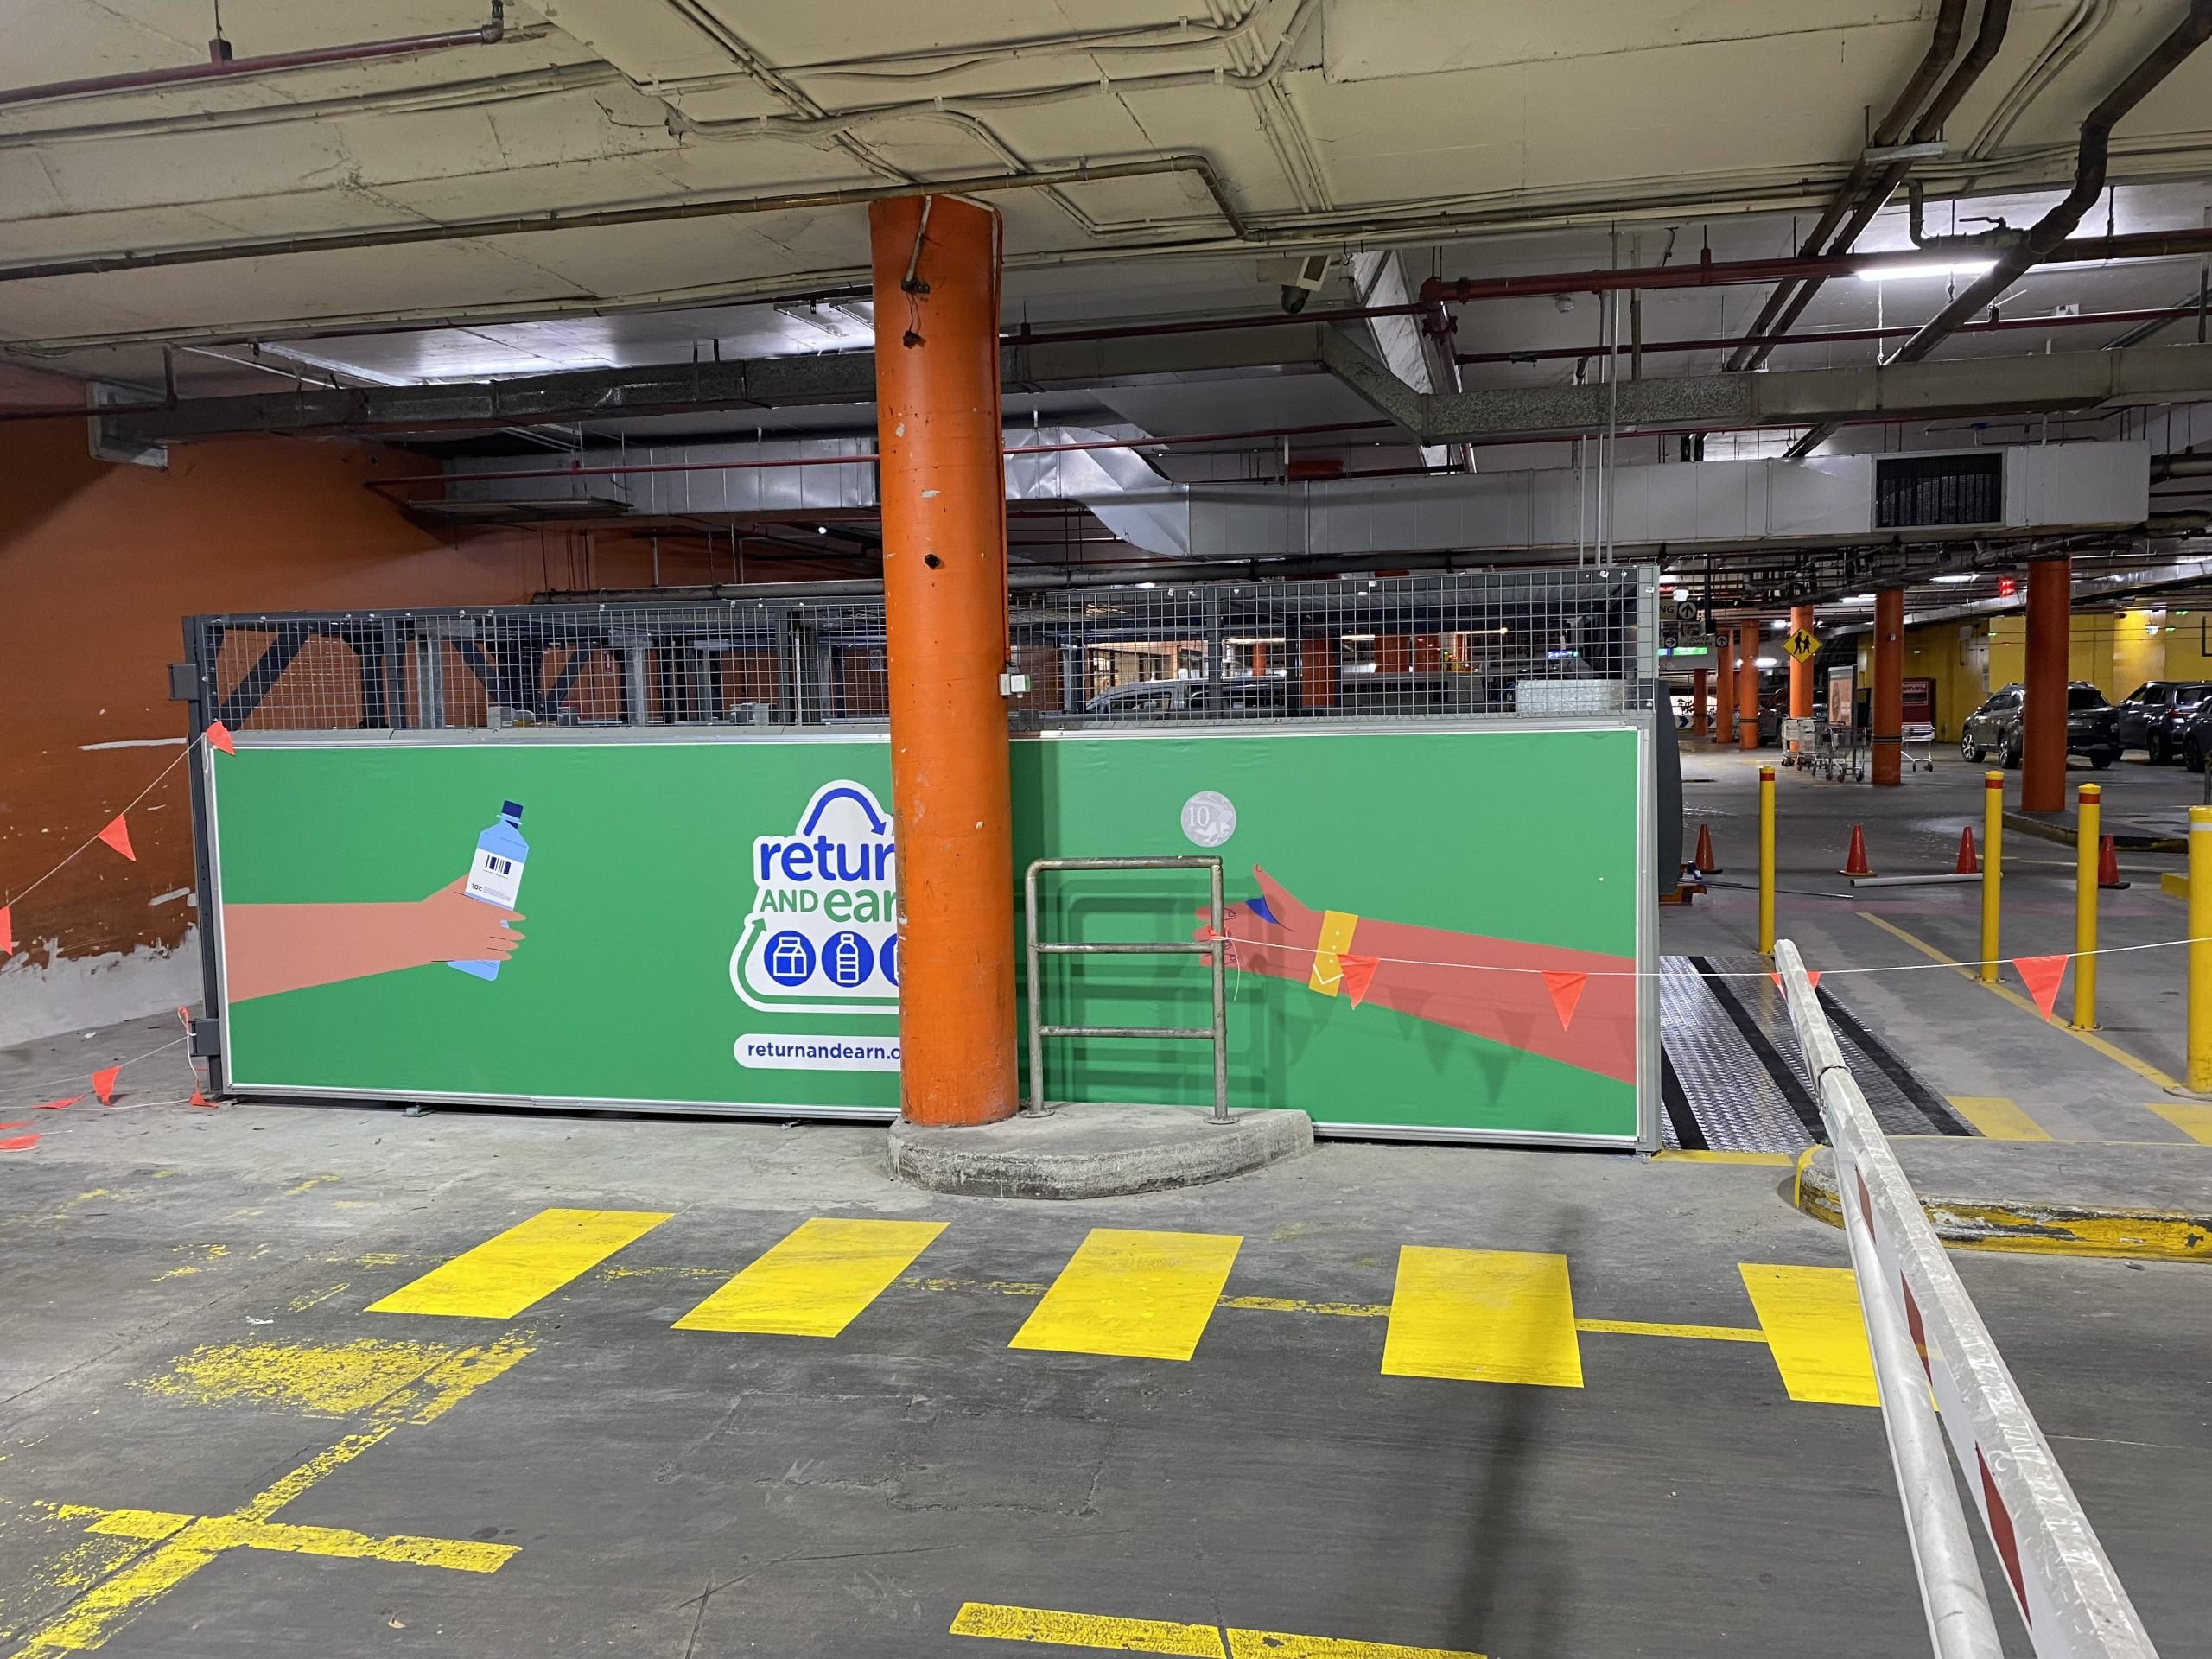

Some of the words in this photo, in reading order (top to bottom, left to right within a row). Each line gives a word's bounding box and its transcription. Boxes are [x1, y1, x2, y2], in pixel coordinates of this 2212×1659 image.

[1189, 805, 1210, 826] 10
[760, 835, 895, 881] retur
[472, 882, 483, 892] 10c
[760, 889, 818, 912] AND
